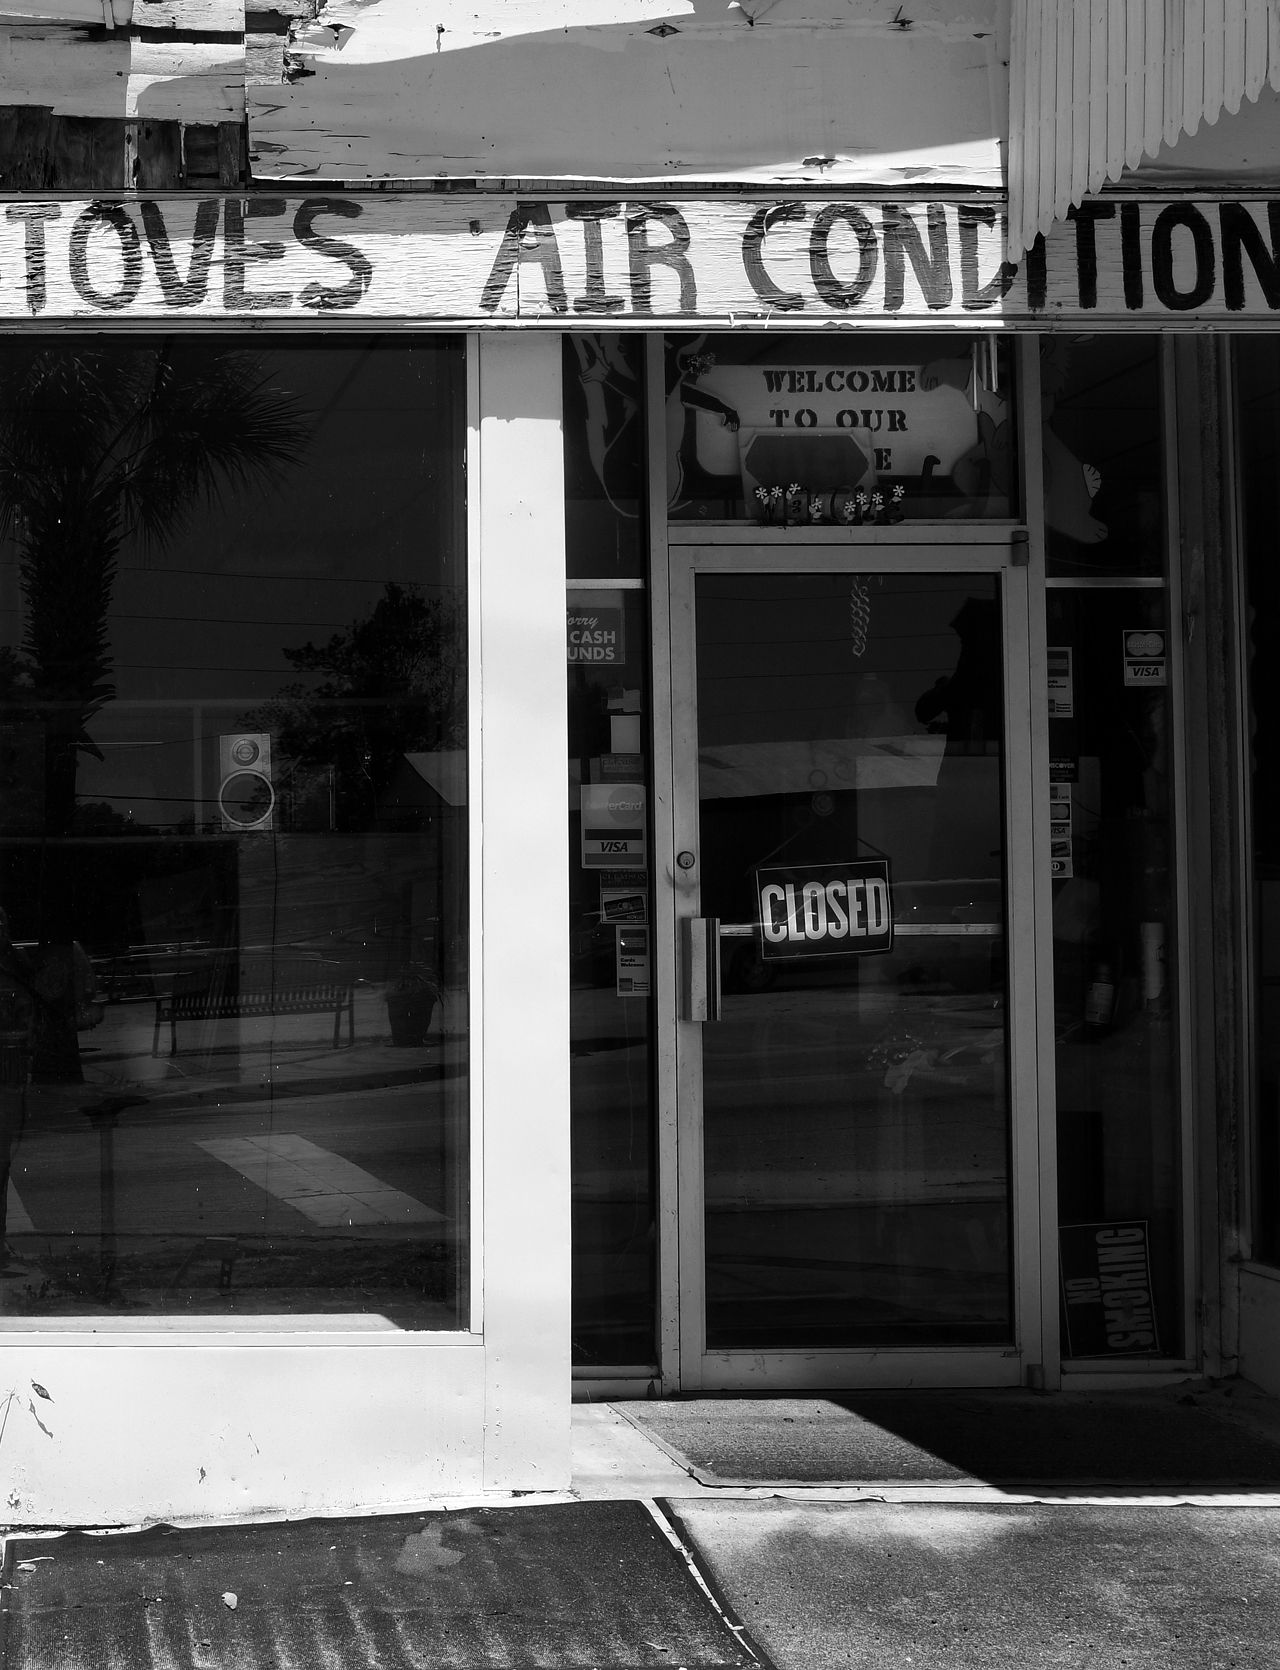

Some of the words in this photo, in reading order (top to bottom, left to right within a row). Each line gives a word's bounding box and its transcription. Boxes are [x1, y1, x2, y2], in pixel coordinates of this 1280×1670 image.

[479, 201, 698, 313] AIR
[762, 369, 916, 393] WELCOME
[769, 408, 818, 428] TO
[835, 408, 909, 432] OUR
[568, 611, 599, 630] orry
[569, 630, 616, 644] CASH
[1133, 667, 1160, 677] VISA
[600, 841, 629, 853] VISA
[761, 877, 889, 943] CLOSED
[1064, 1277, 1102, 1305] NO
[1095, 1228, 1155, 1348] SMOKING
